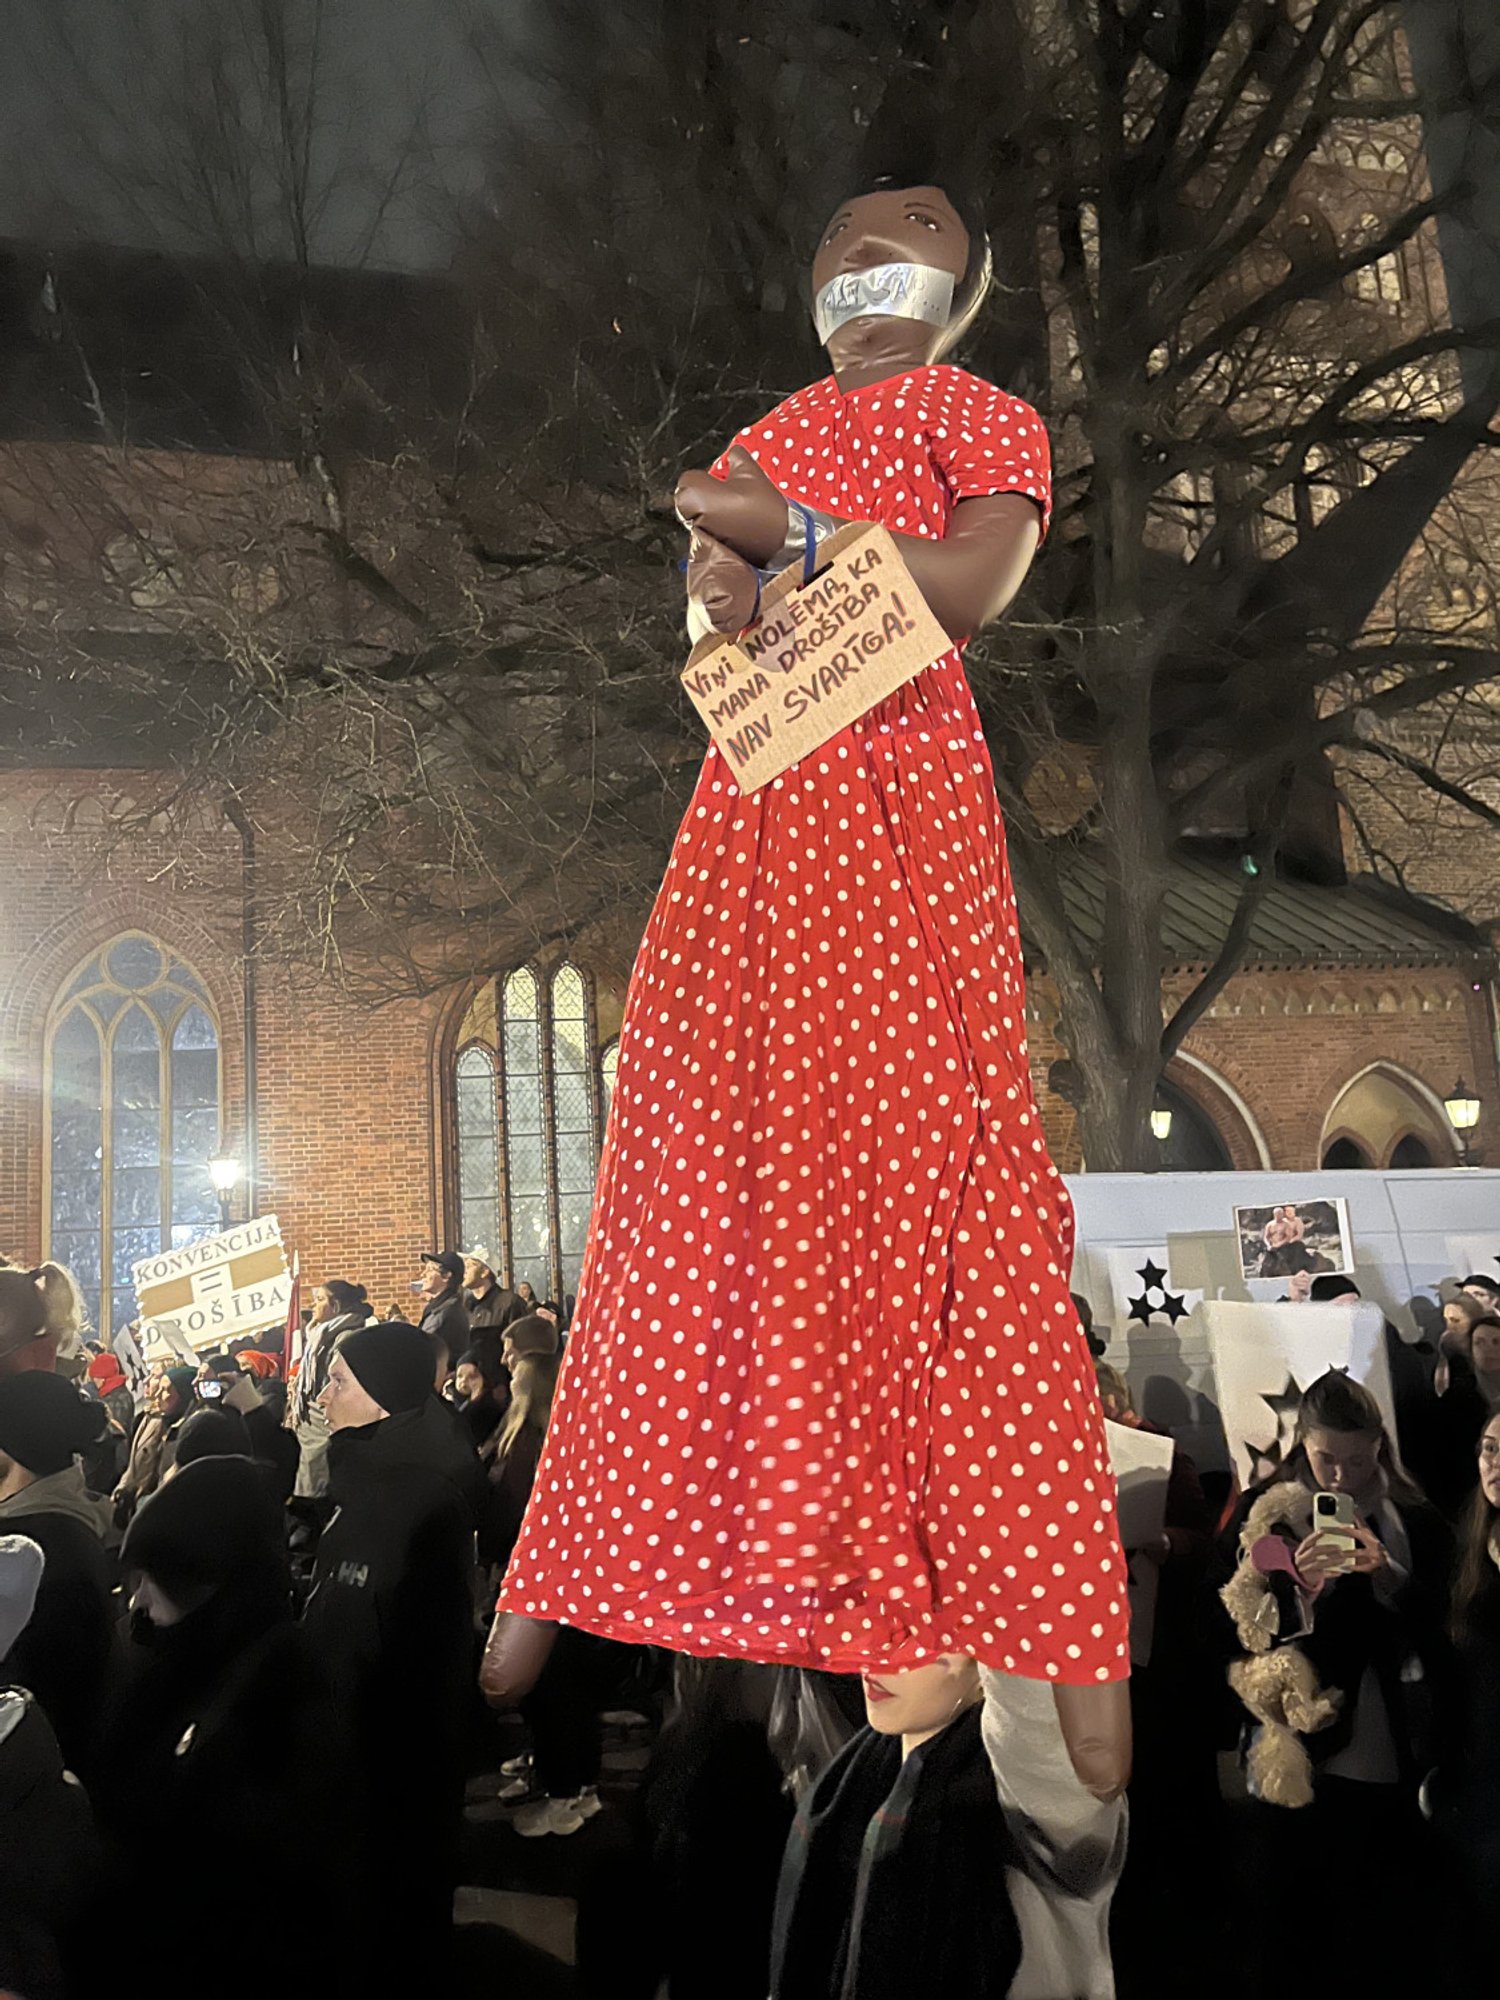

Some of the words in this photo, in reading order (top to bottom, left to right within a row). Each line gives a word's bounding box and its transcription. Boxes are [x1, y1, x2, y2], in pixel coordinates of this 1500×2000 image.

[745, 577, 850, 662] NOLĒMA,
[847, 548, 883, 581] KA
[708, 672, 771, 728] MANA
[726, 713, 773, 768] NAV
[783, 591, 916, 724] SVARĪGA!
[136, 1223, 278, 1285] KONVENCIJA
